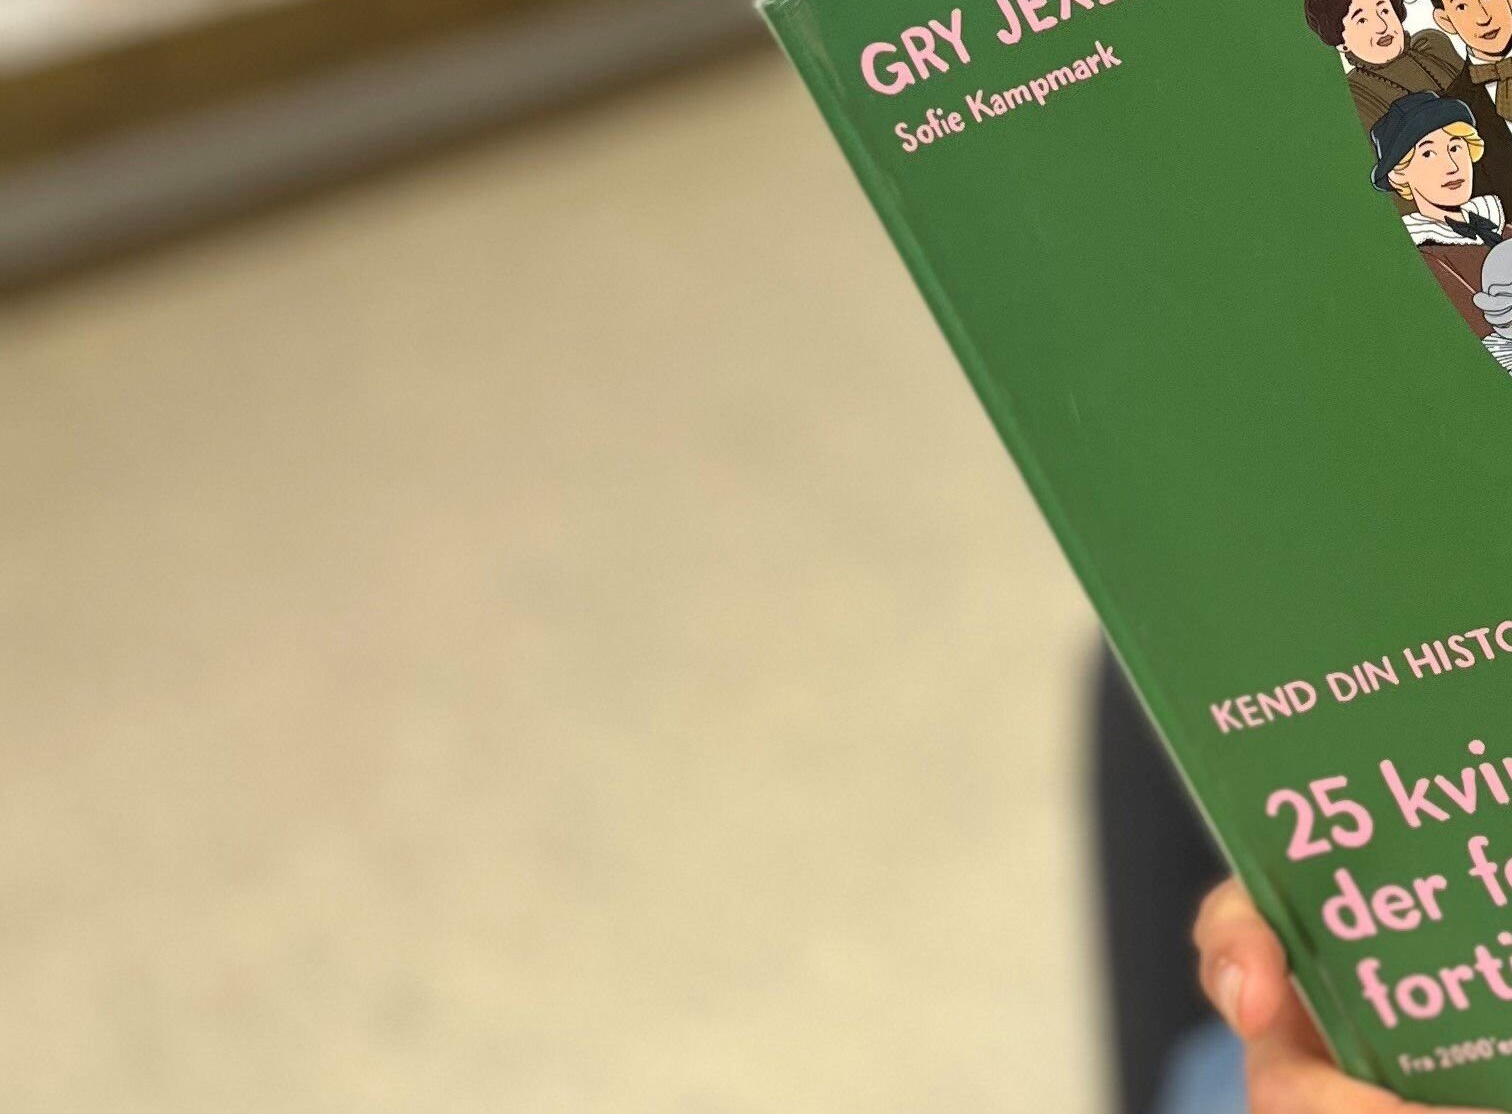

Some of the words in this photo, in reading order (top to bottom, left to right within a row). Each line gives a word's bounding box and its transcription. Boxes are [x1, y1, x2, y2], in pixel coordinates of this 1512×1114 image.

[860, 7, 972, 96] GRY
[894, 107, 966, 154] Sofie
[965, 39, 1122, 124] Kampmark
[1210, 679, 1318, 735] KEND
[1325, 655, 1400, 703] DIN
[1265, 774, 1375, 861] 25
[1321, 867, 1448, 941] der
[1398, 1054, 1435, 1075] Fra
